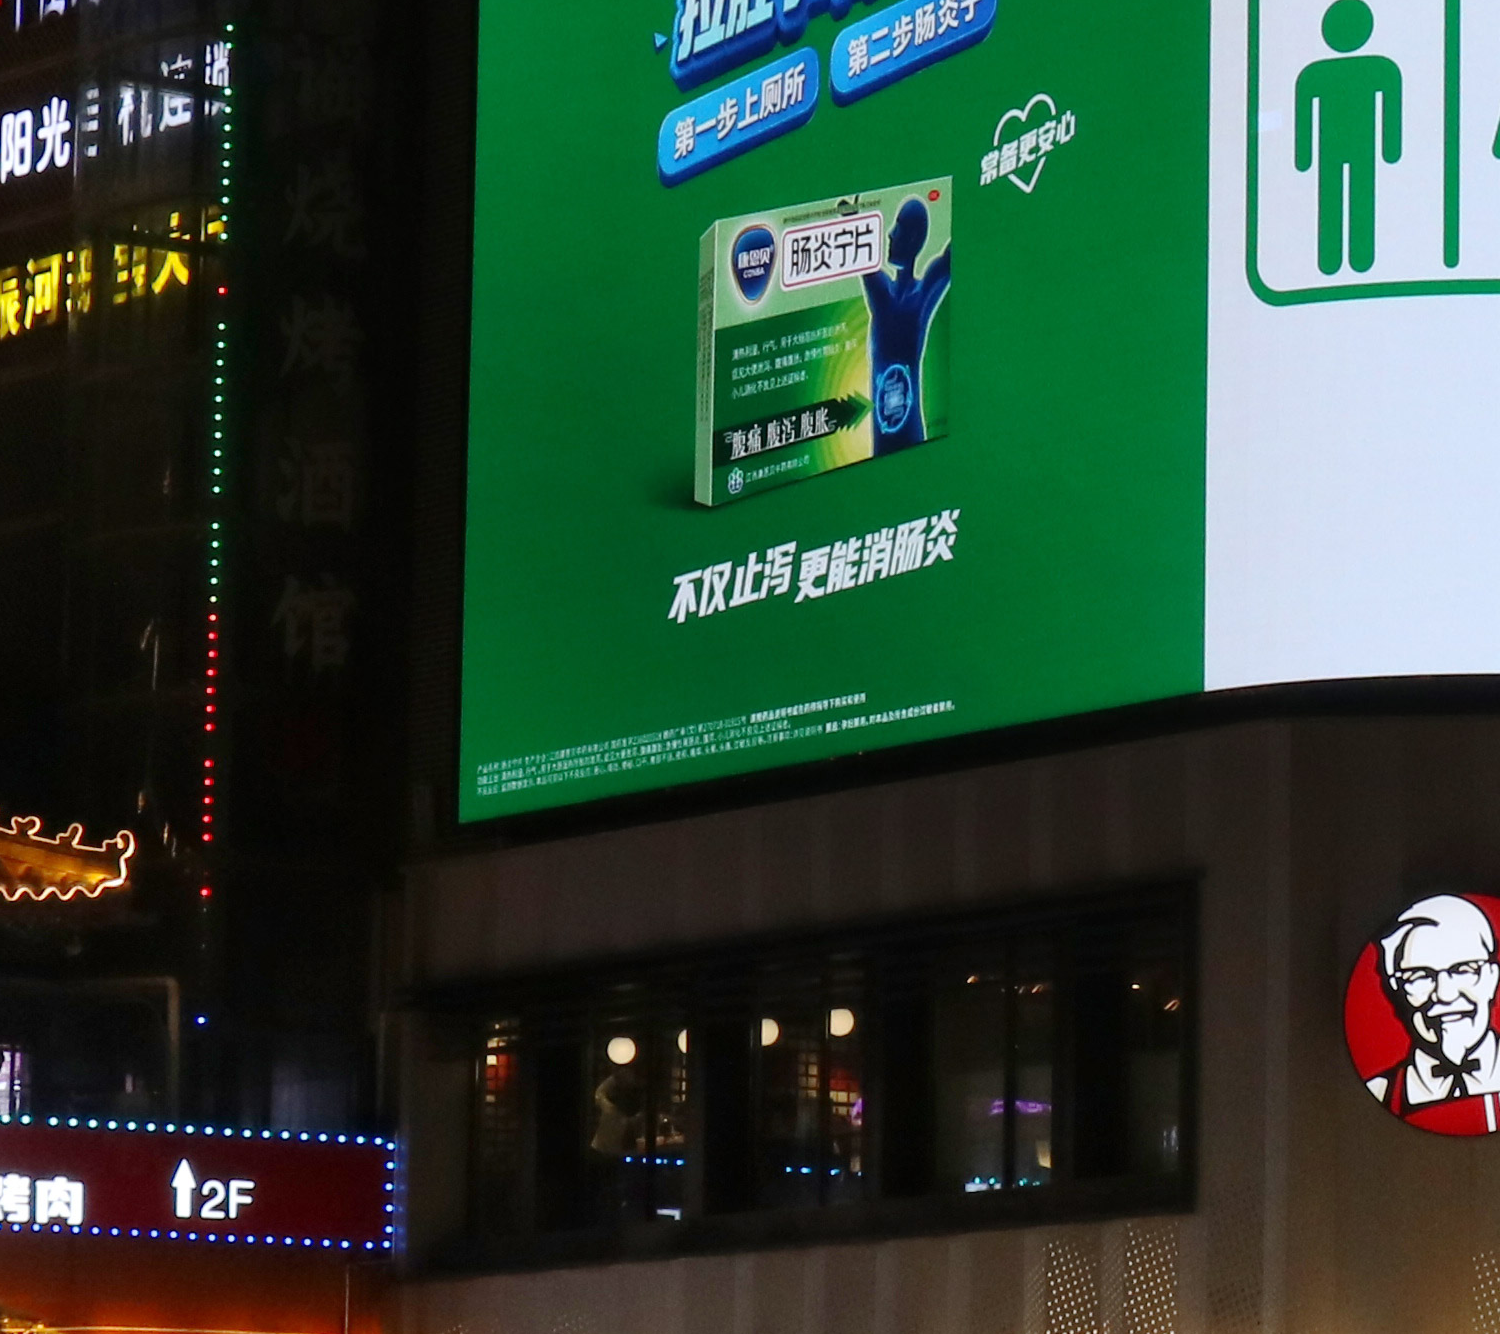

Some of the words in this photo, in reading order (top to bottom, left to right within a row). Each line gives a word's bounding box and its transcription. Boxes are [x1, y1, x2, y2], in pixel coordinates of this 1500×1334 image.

[673, 63, 806, 160] 第一步上厕所
[980, 110, 1076, 186] 常备更安心
[790, 223, 874, 277] 肠炎宁片
[667, 540, 798, 625] 不仅止泻
[794, 509, 963, 604] 更能消肠炎
[201, 1180, 256, 1222] 2F
